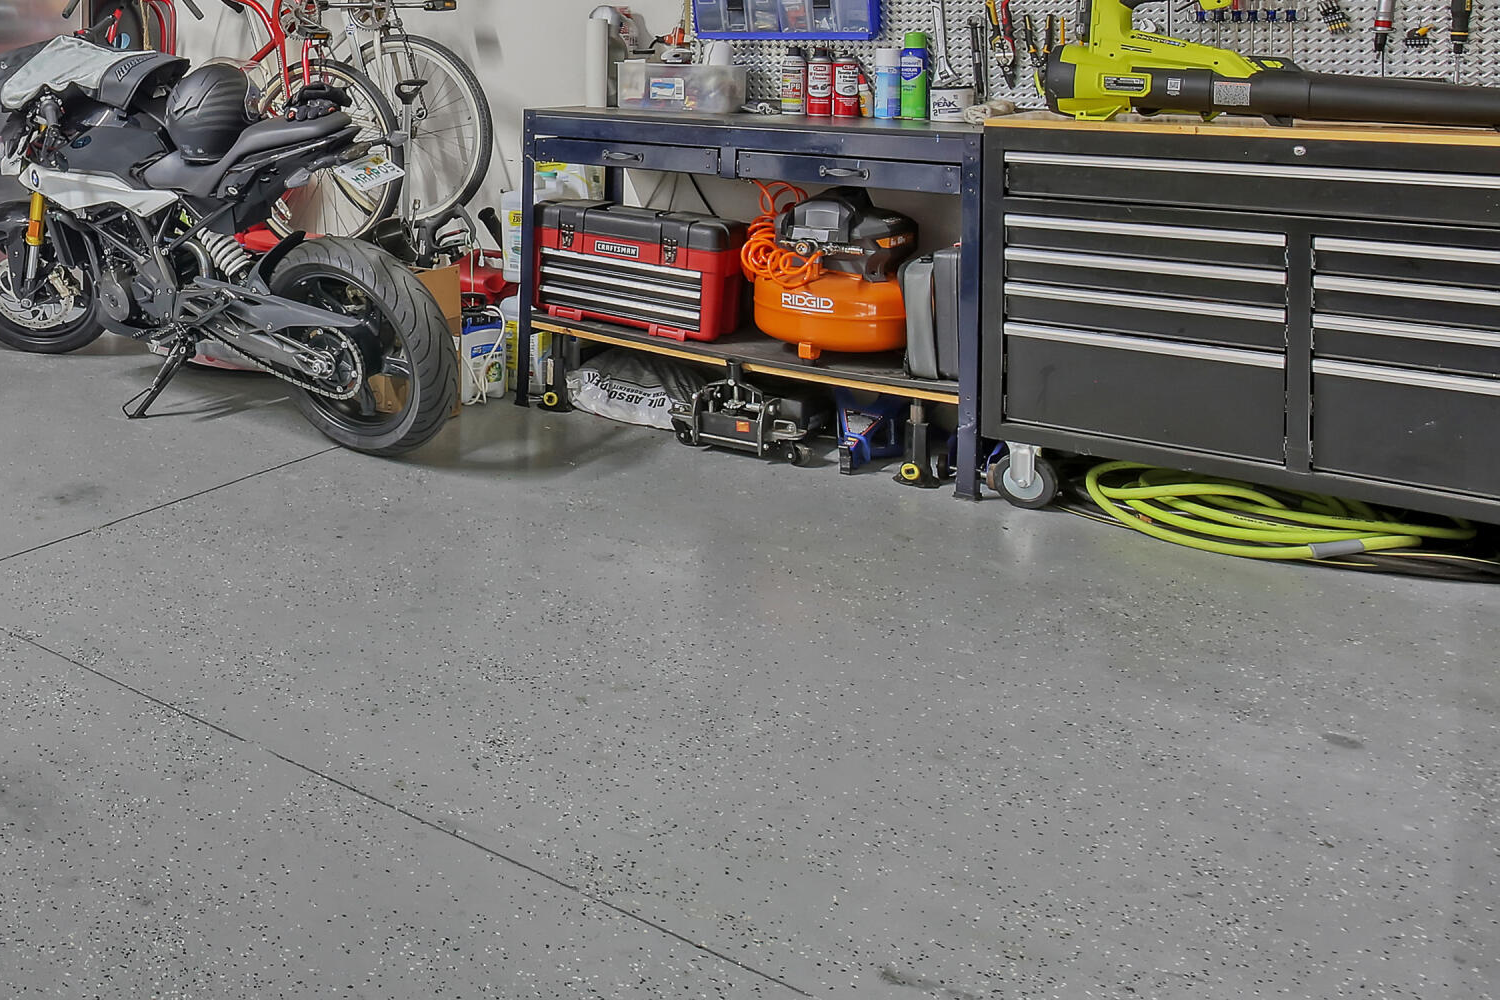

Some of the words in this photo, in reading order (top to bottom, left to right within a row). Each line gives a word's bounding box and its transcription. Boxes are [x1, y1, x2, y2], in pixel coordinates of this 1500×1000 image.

[932, 100, 958, 109] PEAK
[597, 242, 638, 257] CRAFTSMAN
[781, 292, 834, 309] RIDGID
[647, 397, 666, 409] OIL
